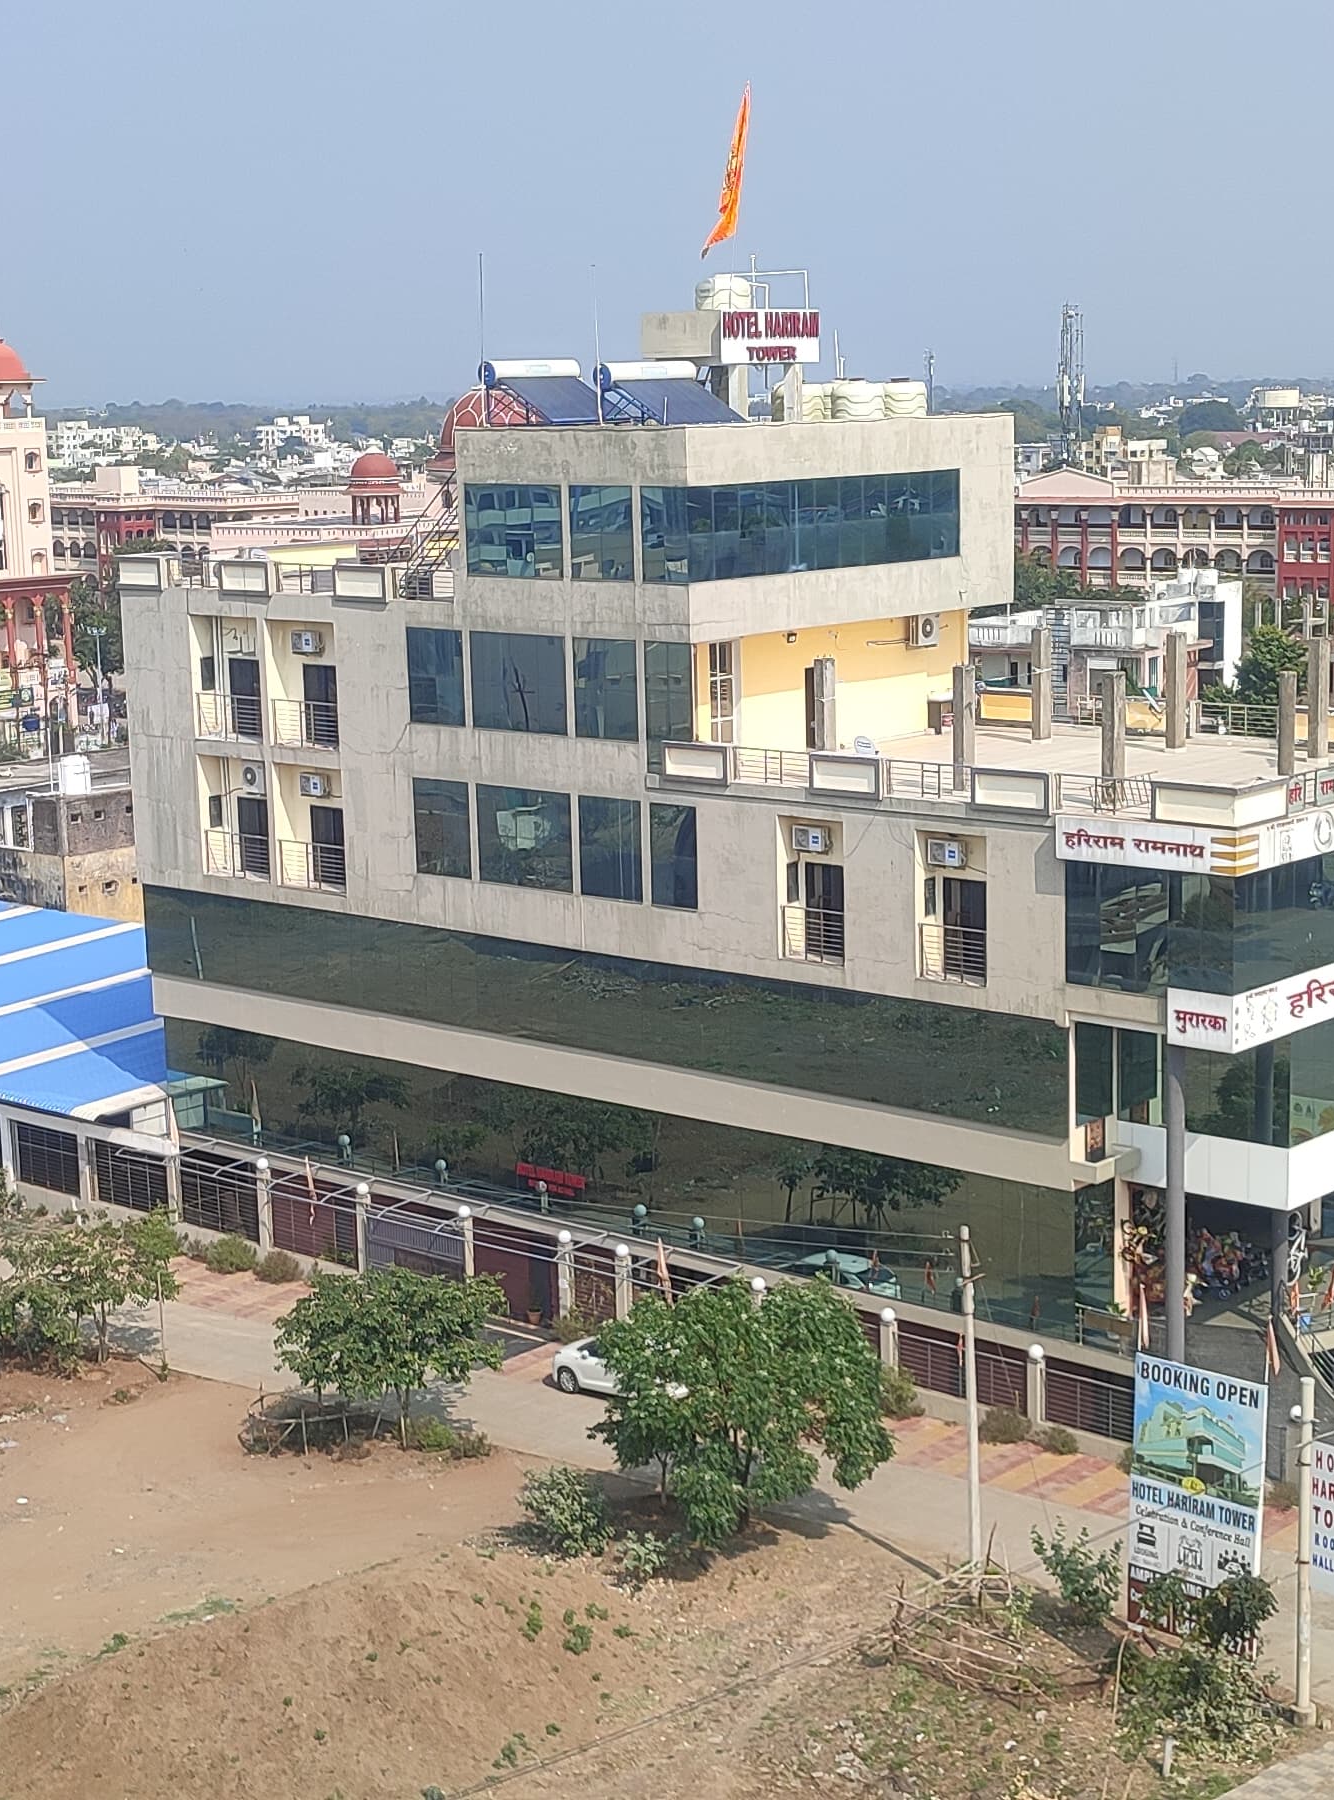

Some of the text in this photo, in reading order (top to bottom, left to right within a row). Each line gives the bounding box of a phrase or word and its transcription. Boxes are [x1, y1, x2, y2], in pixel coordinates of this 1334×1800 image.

[723, 311, 820, 338] HOTEL HARIRAM
[746, 346, 797, 361] TOWER
[1288, 783, 1303, 803] हरि
[1062, 828, 1205, 859] हरिराम रामनाथ
[1174, 1008, 1228, 1034] मुरारका
[1140, 1361, 1260, 1409] BOOKING OPEN
[1132, 1481, 1255, 1533] HOTEL HARIRAM TOWER
[1181, 1518, 1188, 1529] &
[1190, 1520, 1232, 1542] Conference
[1233, 1533, 1250, 1548] Hall
[1313, 1554, 1334, 1572] HALL
